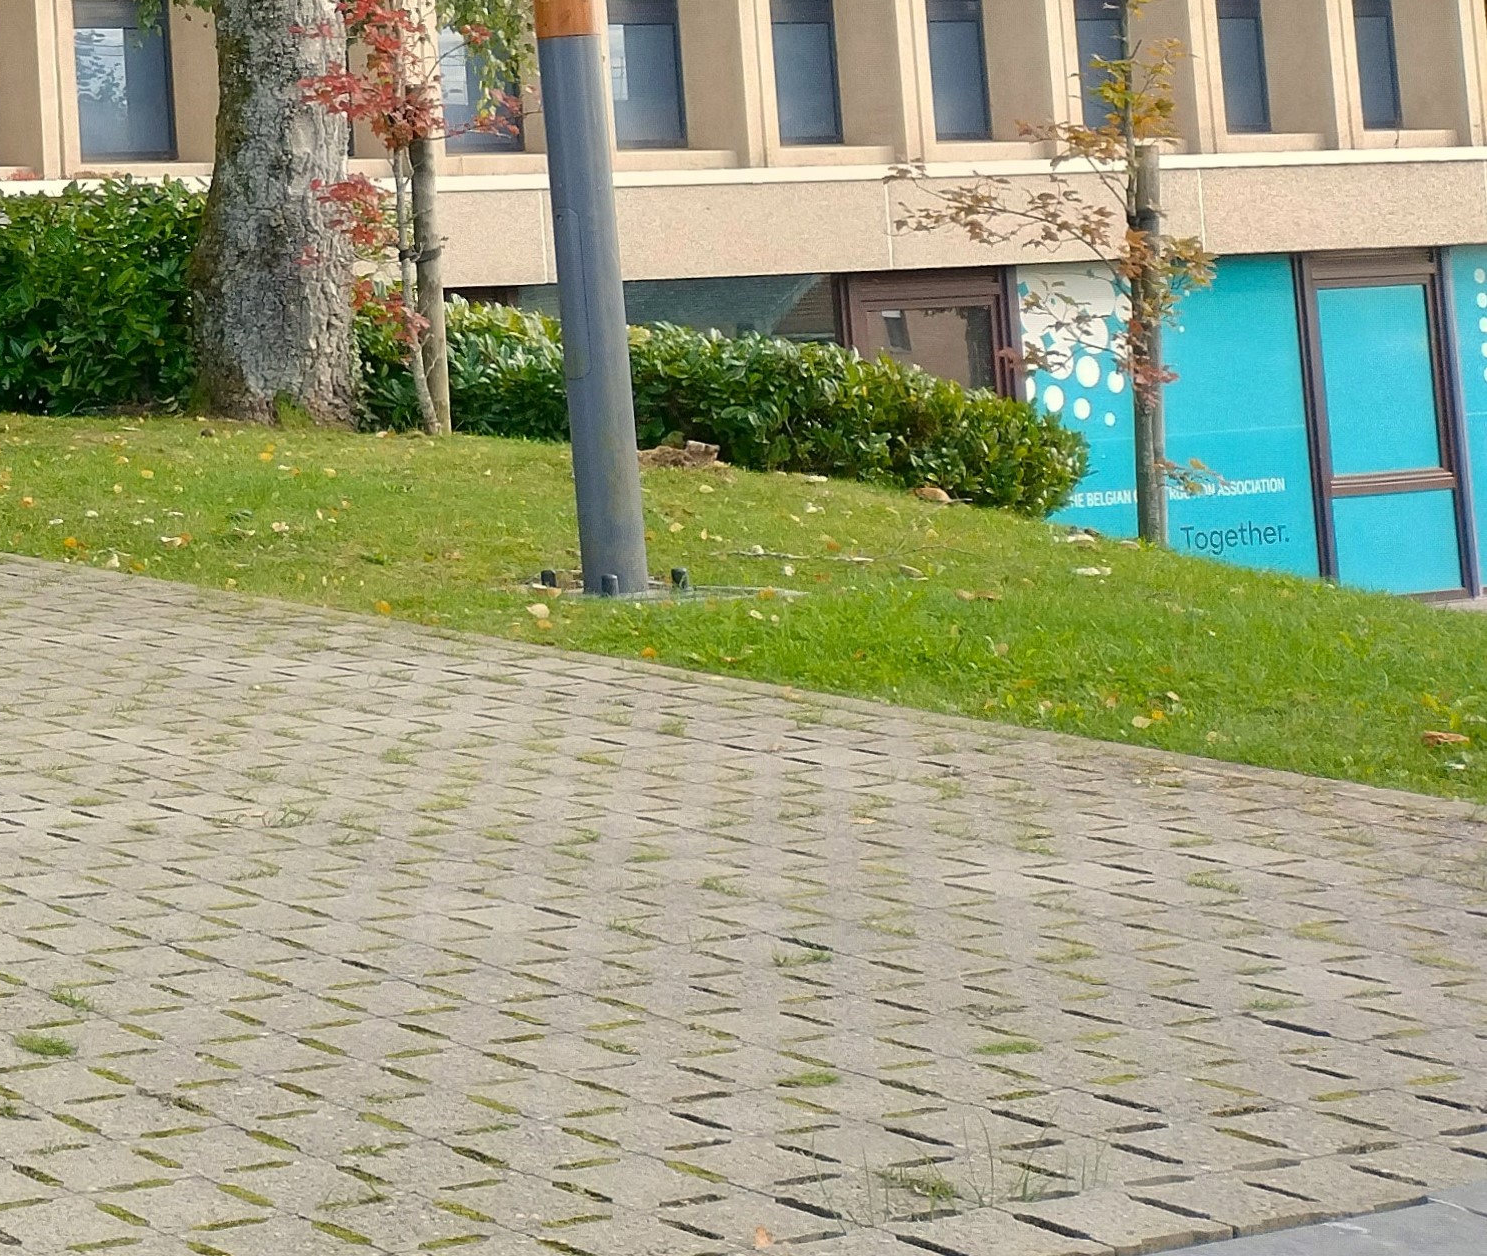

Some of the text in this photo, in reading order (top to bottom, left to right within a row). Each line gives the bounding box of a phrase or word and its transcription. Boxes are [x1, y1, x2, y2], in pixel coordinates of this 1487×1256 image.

[1086, 490, 1132, 507] BELGIAN
[1217, 477, 1285, 496] ASSOCIATION
[1180, 520, 1290, 555] Together.
